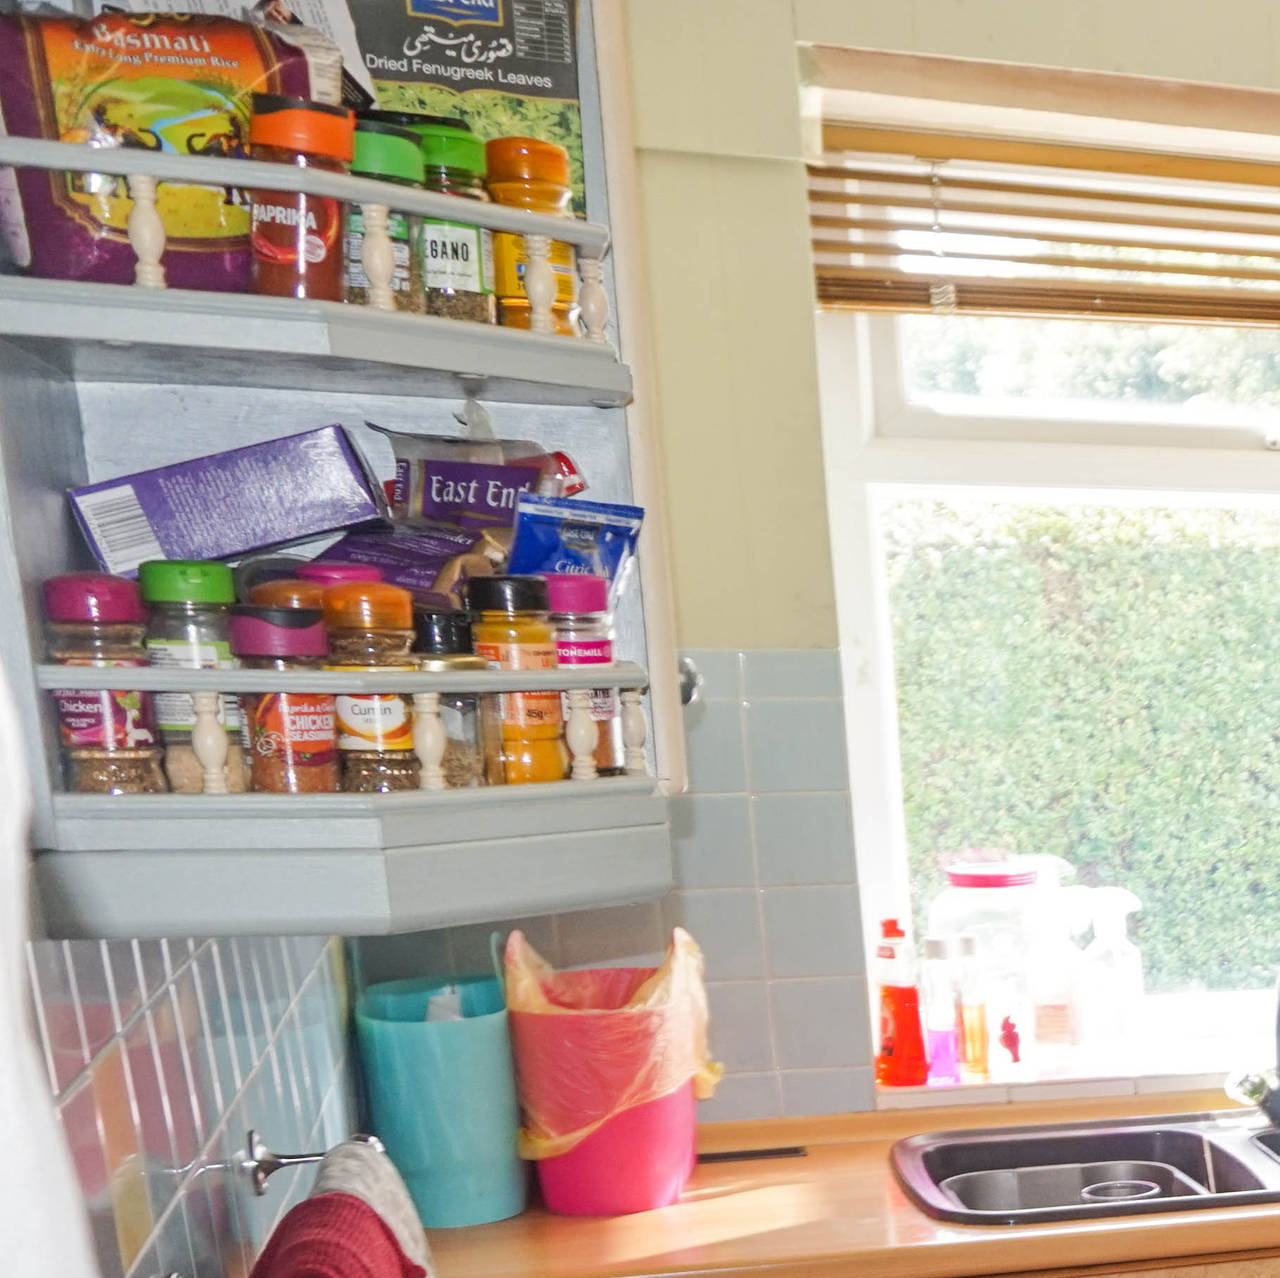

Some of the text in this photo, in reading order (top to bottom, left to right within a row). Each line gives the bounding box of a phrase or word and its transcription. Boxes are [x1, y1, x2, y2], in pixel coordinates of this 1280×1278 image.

[93, 23, 212, 53] Basmati
[108, 47, 142, 65] Long
[143, 52, 207, 66] Premium
[209, 55, 239, 68] Rice
[365, 53, 553, 88] Dried Fenugreek Leaves
[252, 203, 318, 230] PAPRIKA
[429, 475, 479, 506] East
[554, 560, 591, 575] Citric
[60, 700, 102, 713] Chicken
[350, 704, 392, 716] Cumn
